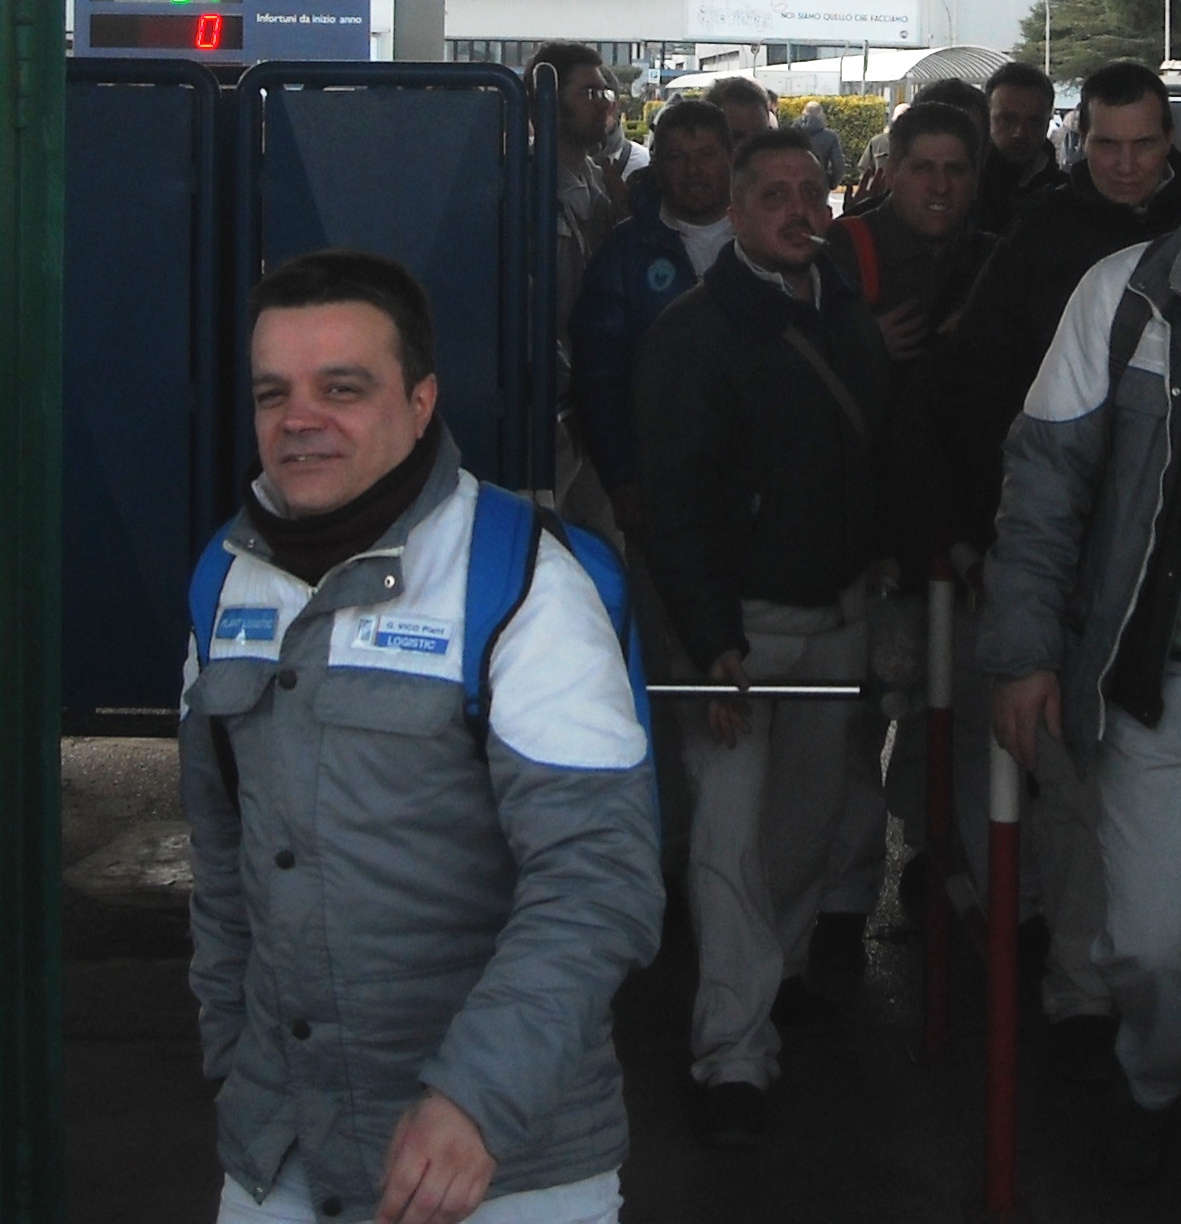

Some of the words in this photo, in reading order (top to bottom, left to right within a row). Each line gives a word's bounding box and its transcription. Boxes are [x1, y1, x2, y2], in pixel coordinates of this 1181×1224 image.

[256, 13, 297, 23] Infortuni
[299, 14, 311, 24] da
[312, 14, 337, 24] inizio
[339, 16, 363, 24] anno
[197, 13, 222, 50] 0
[386, 635, 436, 651] LOGISTIC
